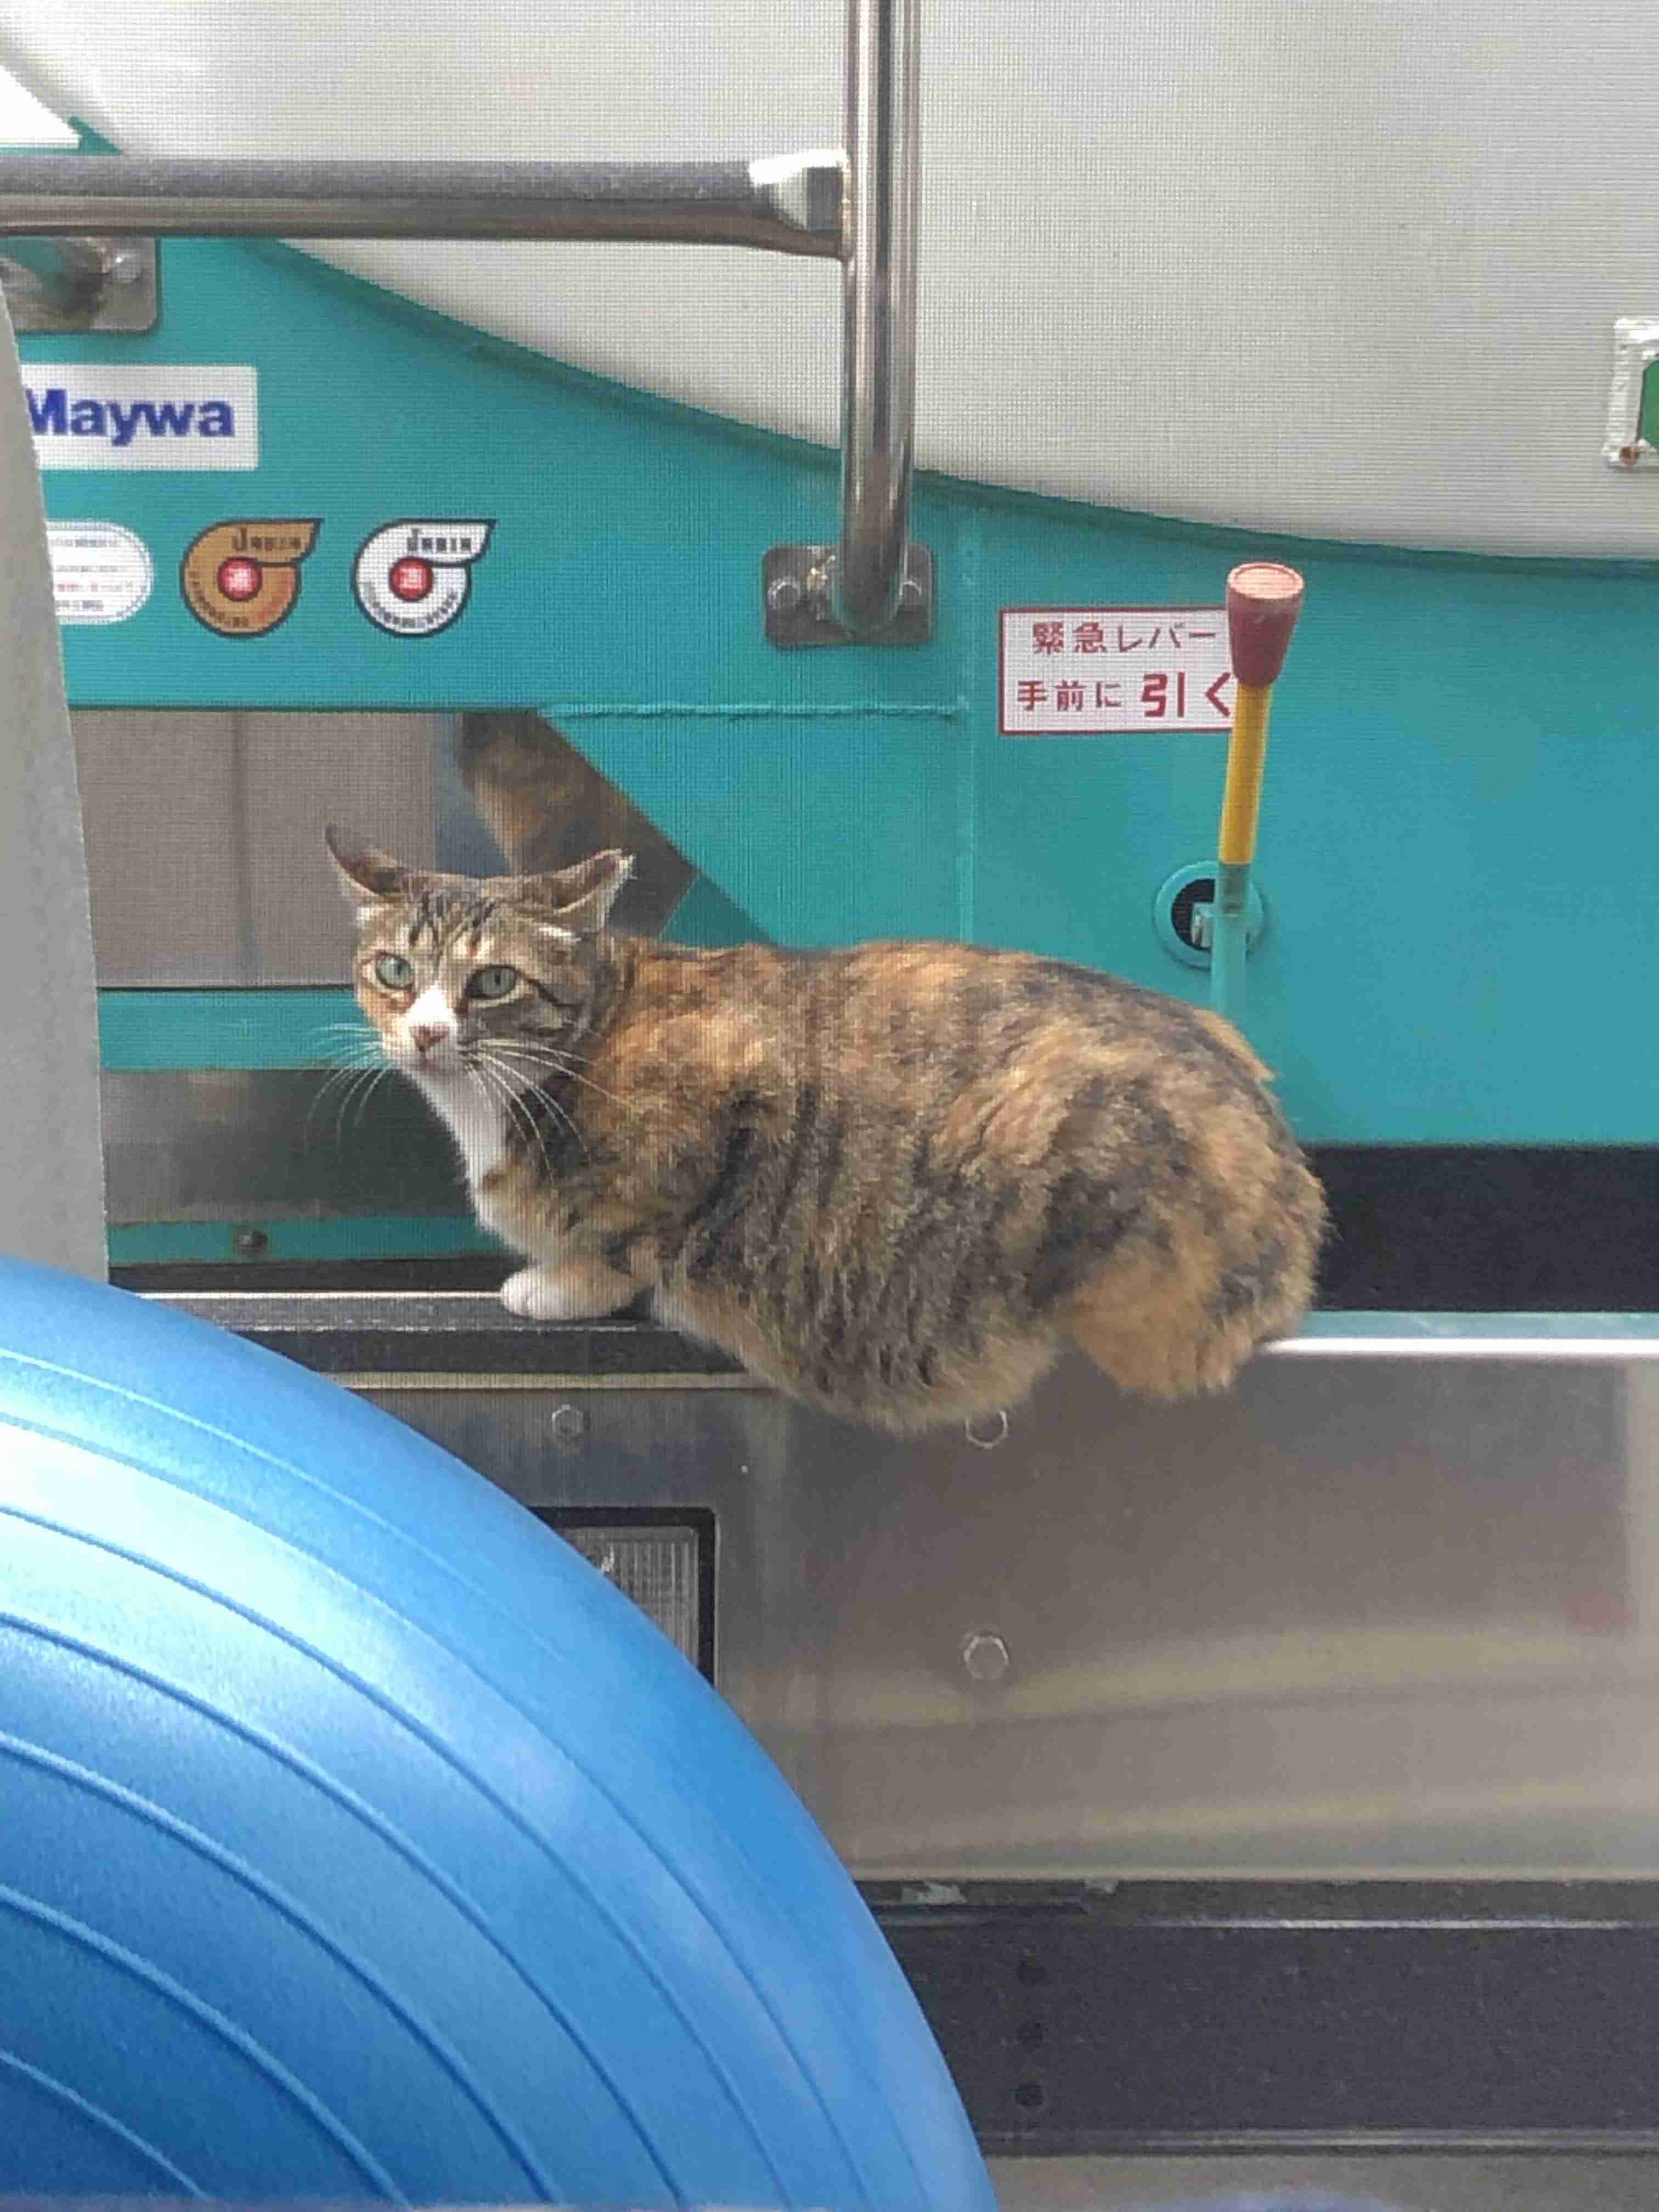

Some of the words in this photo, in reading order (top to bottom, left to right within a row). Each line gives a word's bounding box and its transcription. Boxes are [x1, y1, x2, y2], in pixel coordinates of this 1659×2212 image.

[26, 388, 235, 447] Maywa
[1032, 622, 1216, 655] 緊急レバー
[1017, 672, 1232, 718] 手前に引く
